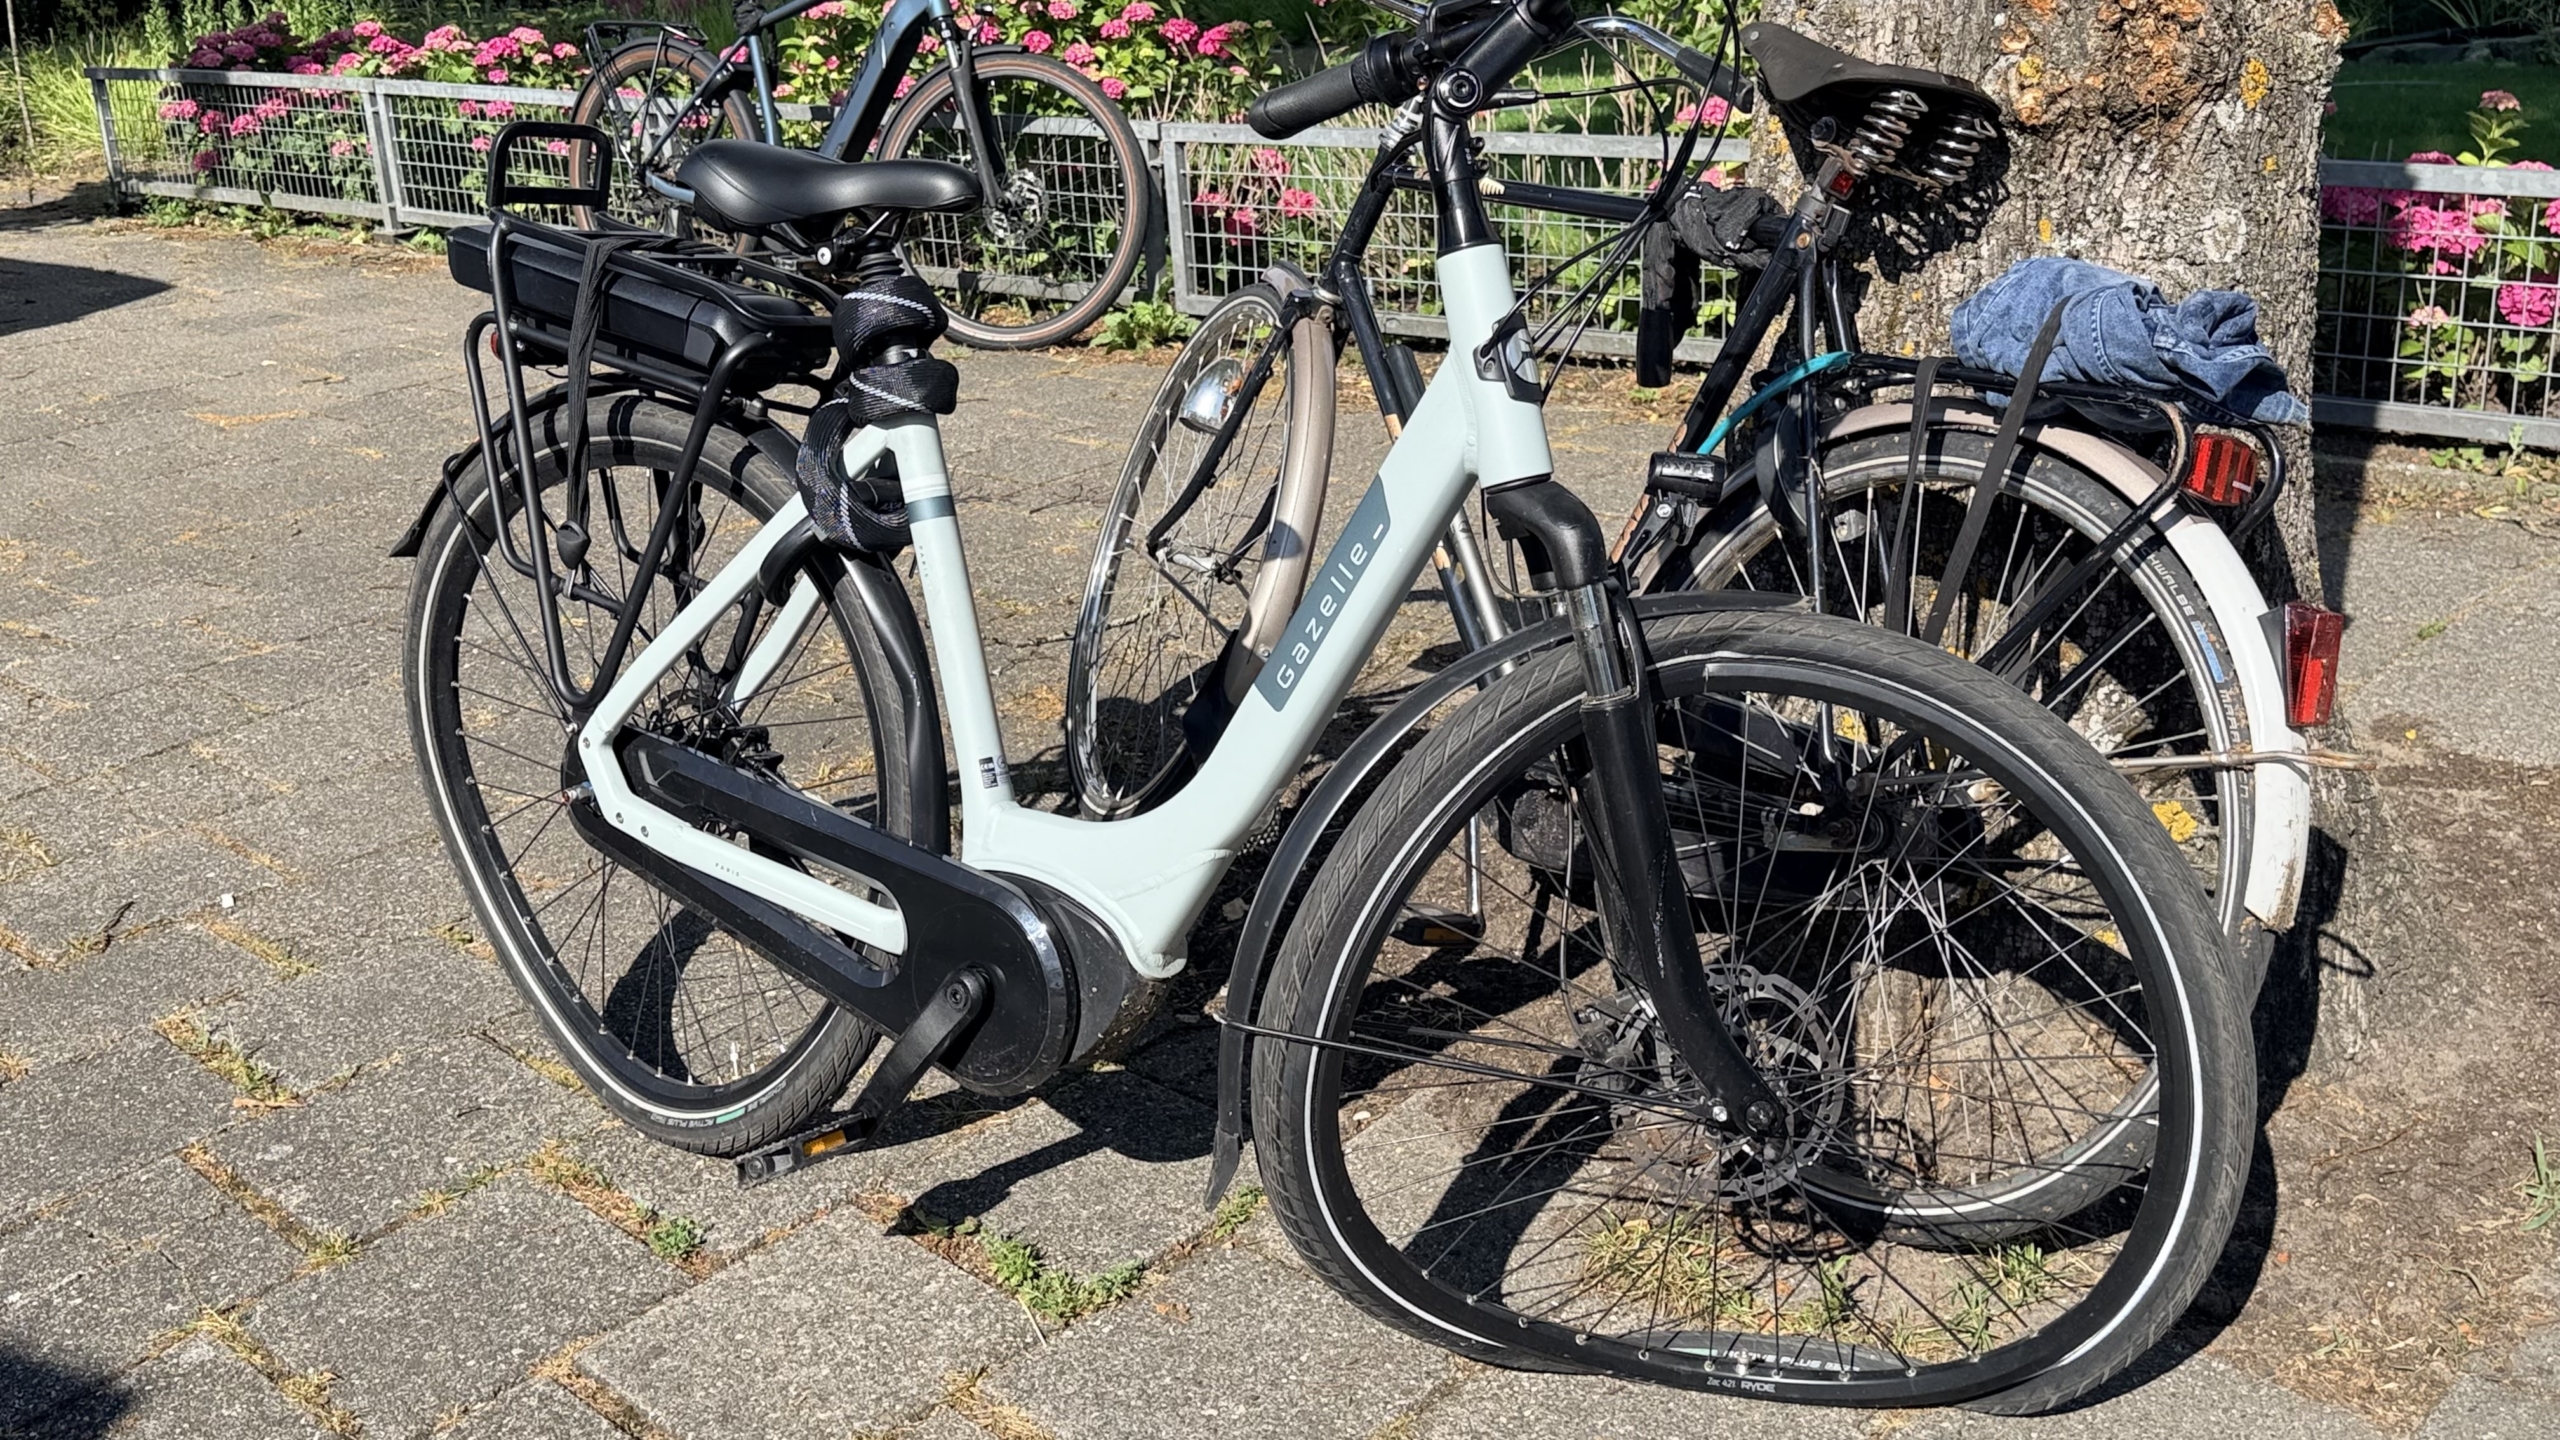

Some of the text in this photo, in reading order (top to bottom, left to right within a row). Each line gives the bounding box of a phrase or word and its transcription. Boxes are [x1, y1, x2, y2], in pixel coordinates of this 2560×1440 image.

[2131, 537, 2196, 617] SCHWALBE
[1276, 542, 1369, 689] Gazelle
[715, 862, 740, 877] PARIS
[1780, 1356, 1821, 1369] PLUS
[1741, 1381, 1776, 1393] RYDE
